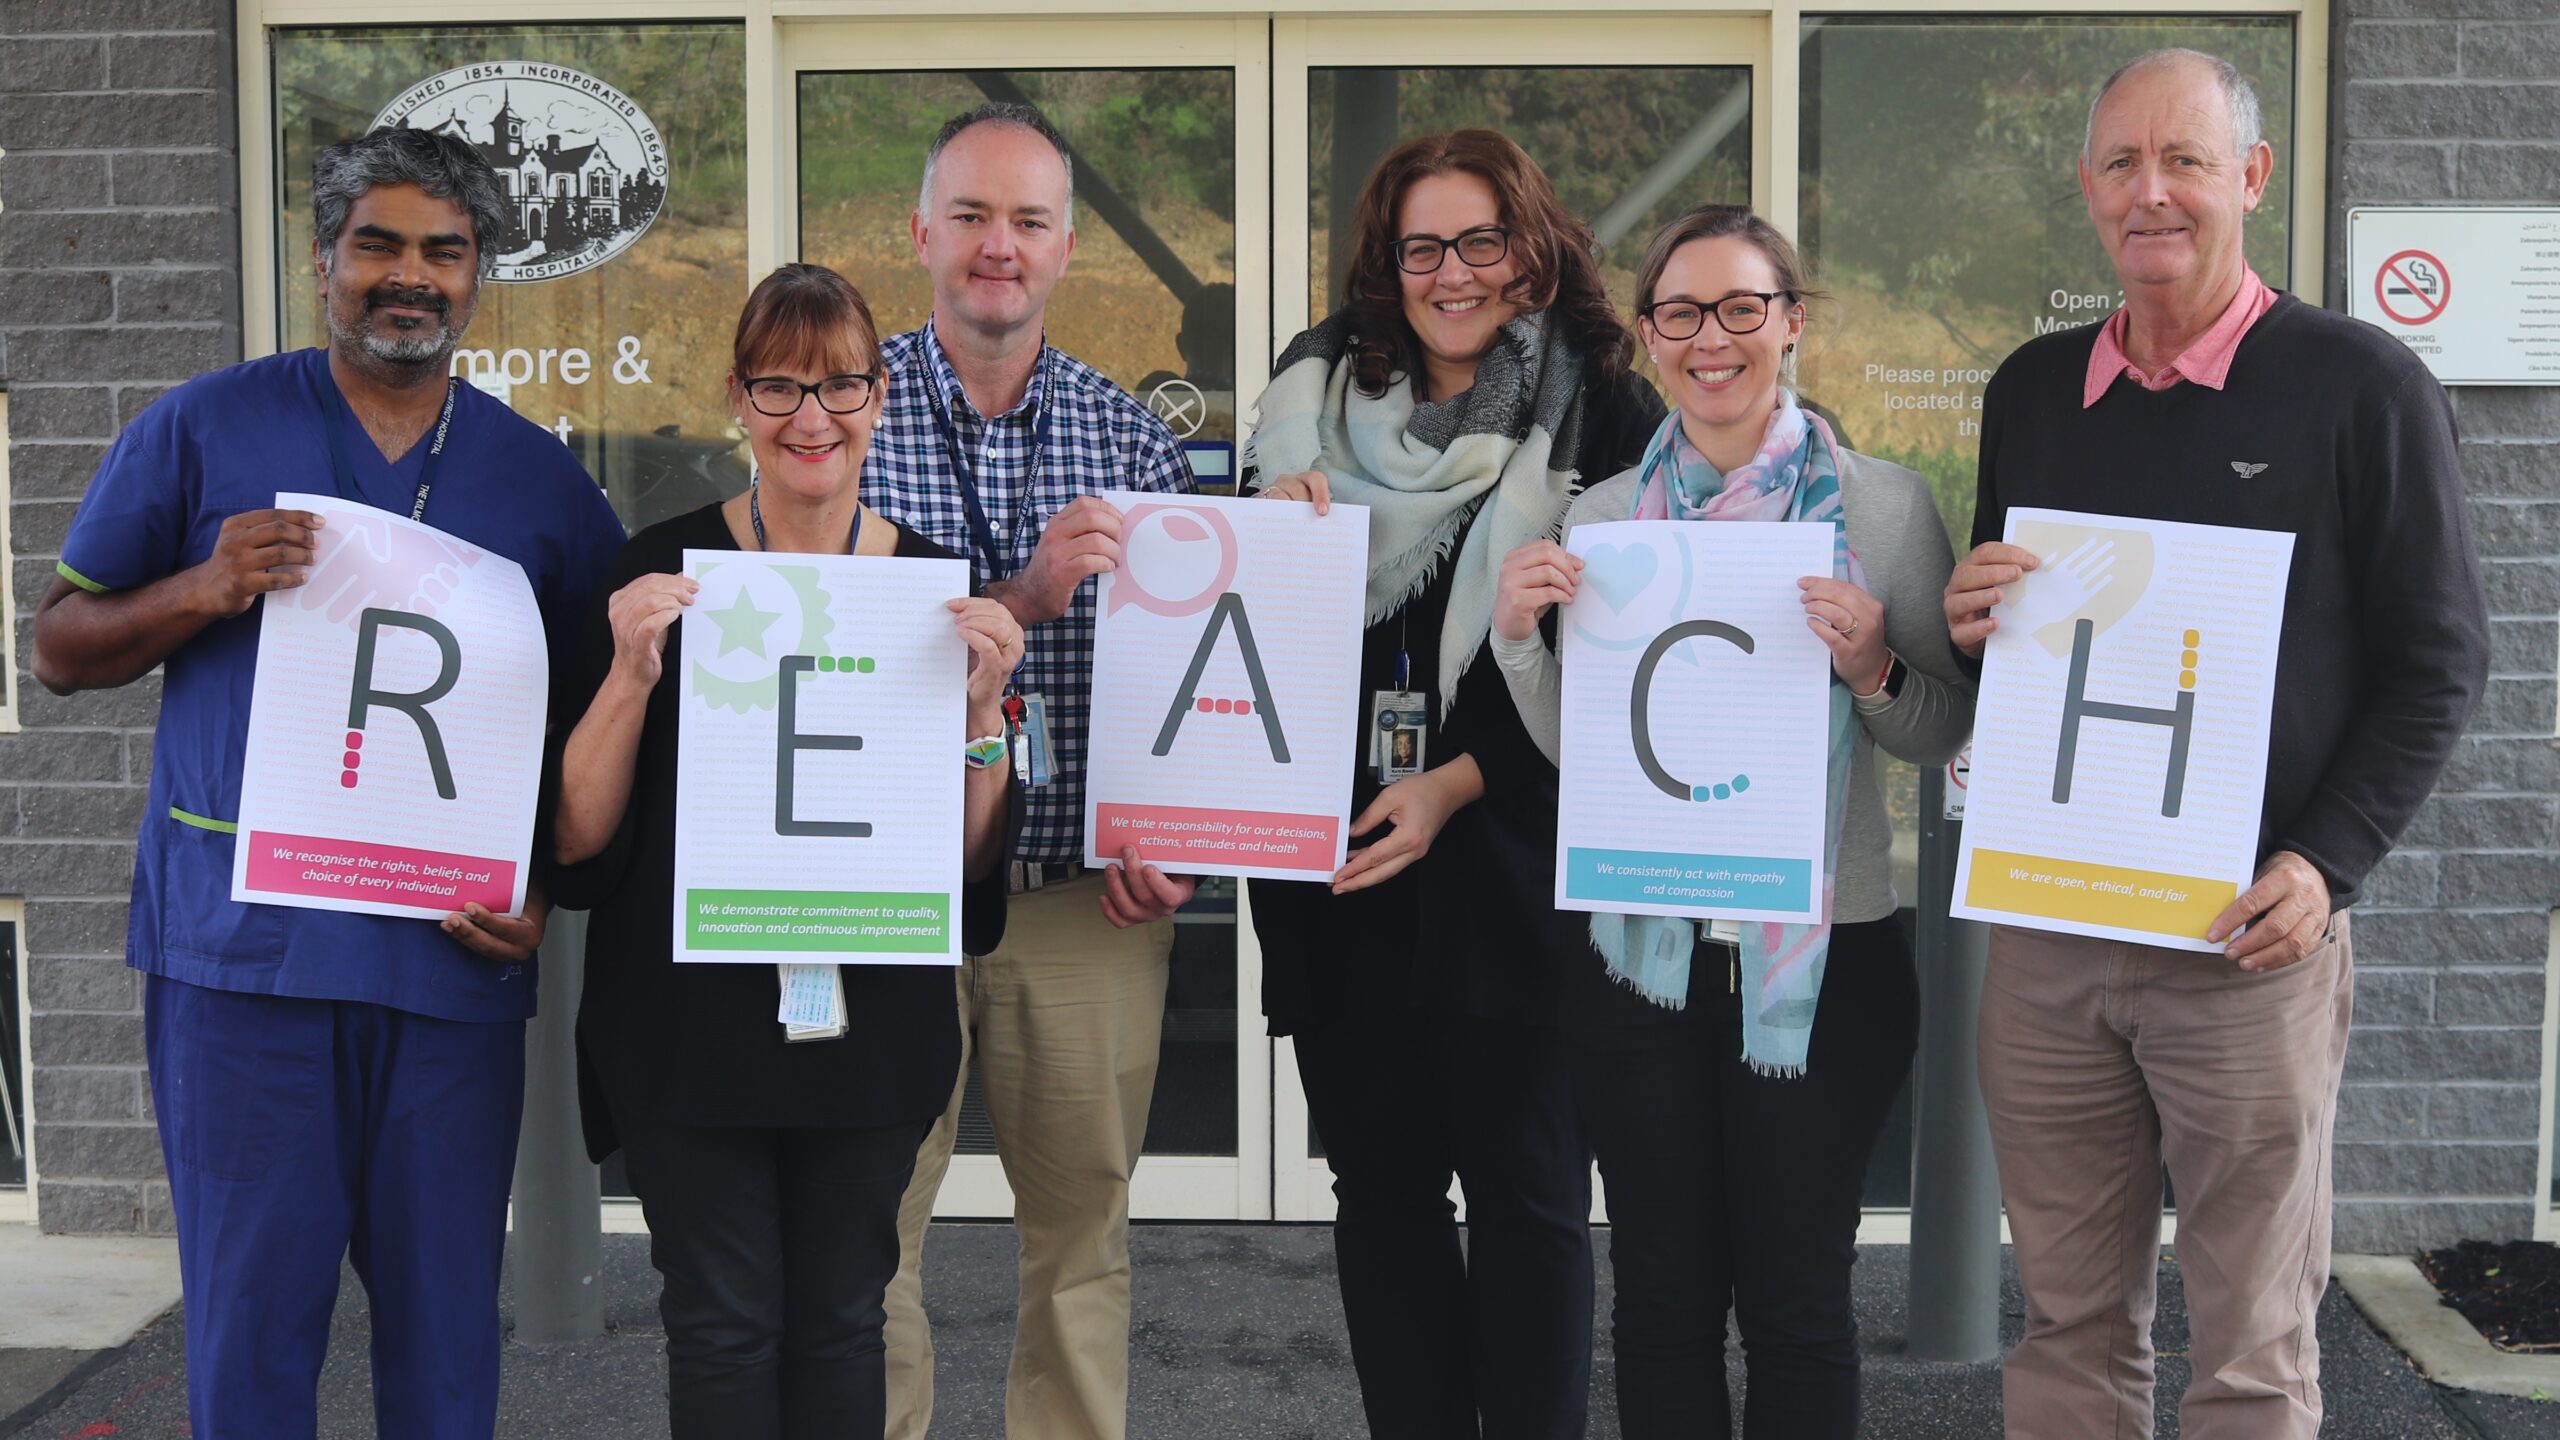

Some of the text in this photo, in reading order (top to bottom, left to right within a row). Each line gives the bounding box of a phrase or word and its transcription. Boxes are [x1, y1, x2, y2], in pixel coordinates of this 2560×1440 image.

[464, 64, 504, 81] 1854
[521, 64, 636, 118] INCORPORATED
[641, 127, 663, 165] 1864
[2051, 289, 2109, 313] Open
[2394, 335, 2436, 343] MOKING
[2411, 346, 2442, 354] BITED
[450, 335, 653, 385] more &
[918, 349, 932, 378] DISTRICT
[926, 378, 942, 412] HOSPITAL
[1865, 364, 1993, 387] Please proc
[1043, 401, 1051, 414] THE
[1884, 391, 1963, 410] located
[431, 421, 449, 455] HOSPITAL
[1023, 476, 1035, 508] DISTRICT
[1032, 442, 1043, 475] HOSPITAL
[417, 483, 430, 499] THE
[1151, 592, 1292, 763] A
[340, 607, 457, 800] R
[1631, 619, 1755, 802] C
[2051, 618, 2200, 818] H
[775, 655, 876, 838] E
[1111, 816, 1328, 842] We take responsibility for our decisions,
[1139, 836, 1299, 854] actions, attitudes and health
[273, 847, 491, 884] We recognise the rights, beliefs and
[1597, 863, 1785, 886] We consistently act with empathy
[302, 870, 457, 897] choice of every individual
[1643, 884, 1735, 900] and compassion
[2009, 868, 2188, 903] We are open, ethical, and fair
[699, 903, 941, 920] We demonstrate commitment to quality,
[698, 921, 941, 938] innovation and continuous improvement
